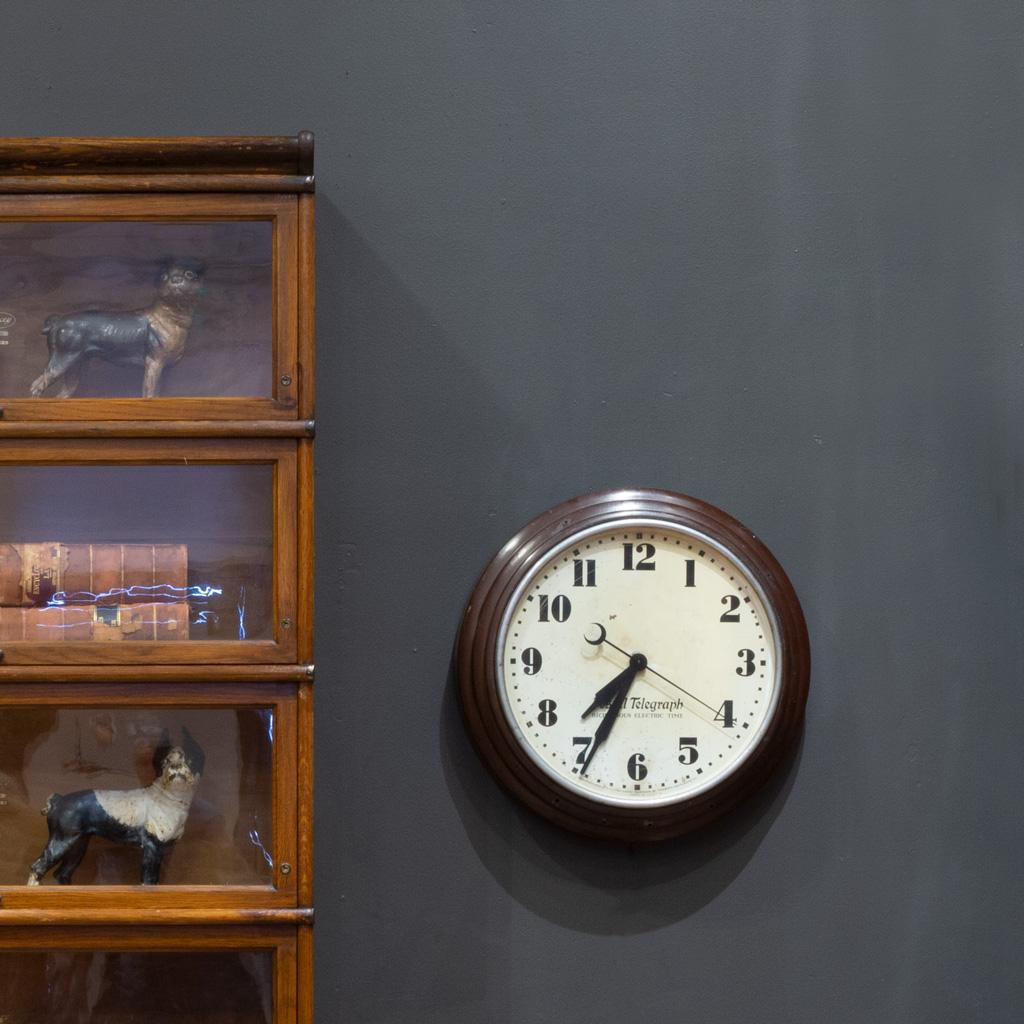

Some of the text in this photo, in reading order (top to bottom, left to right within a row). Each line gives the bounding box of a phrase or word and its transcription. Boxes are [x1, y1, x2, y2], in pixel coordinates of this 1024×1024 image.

[622, 543, 656, 571] 12
[572, 559, 597, 587] 11
[685, 560, 696, 587] 1
[538, 594, 572, 622] 10
[720, 594, 741, 623] 2
[521, 647, 543, 676] 9
[735, 648, 756, 677] 3
[538, 699, 558, 727] 8
[630, 696, 684, 713] Telegraph
[713, 700, 737, 728] 4
[572, 737, 593, 765] 7
[678, 737, 699, 765] 5
[627, 753, 648, 781] 6
